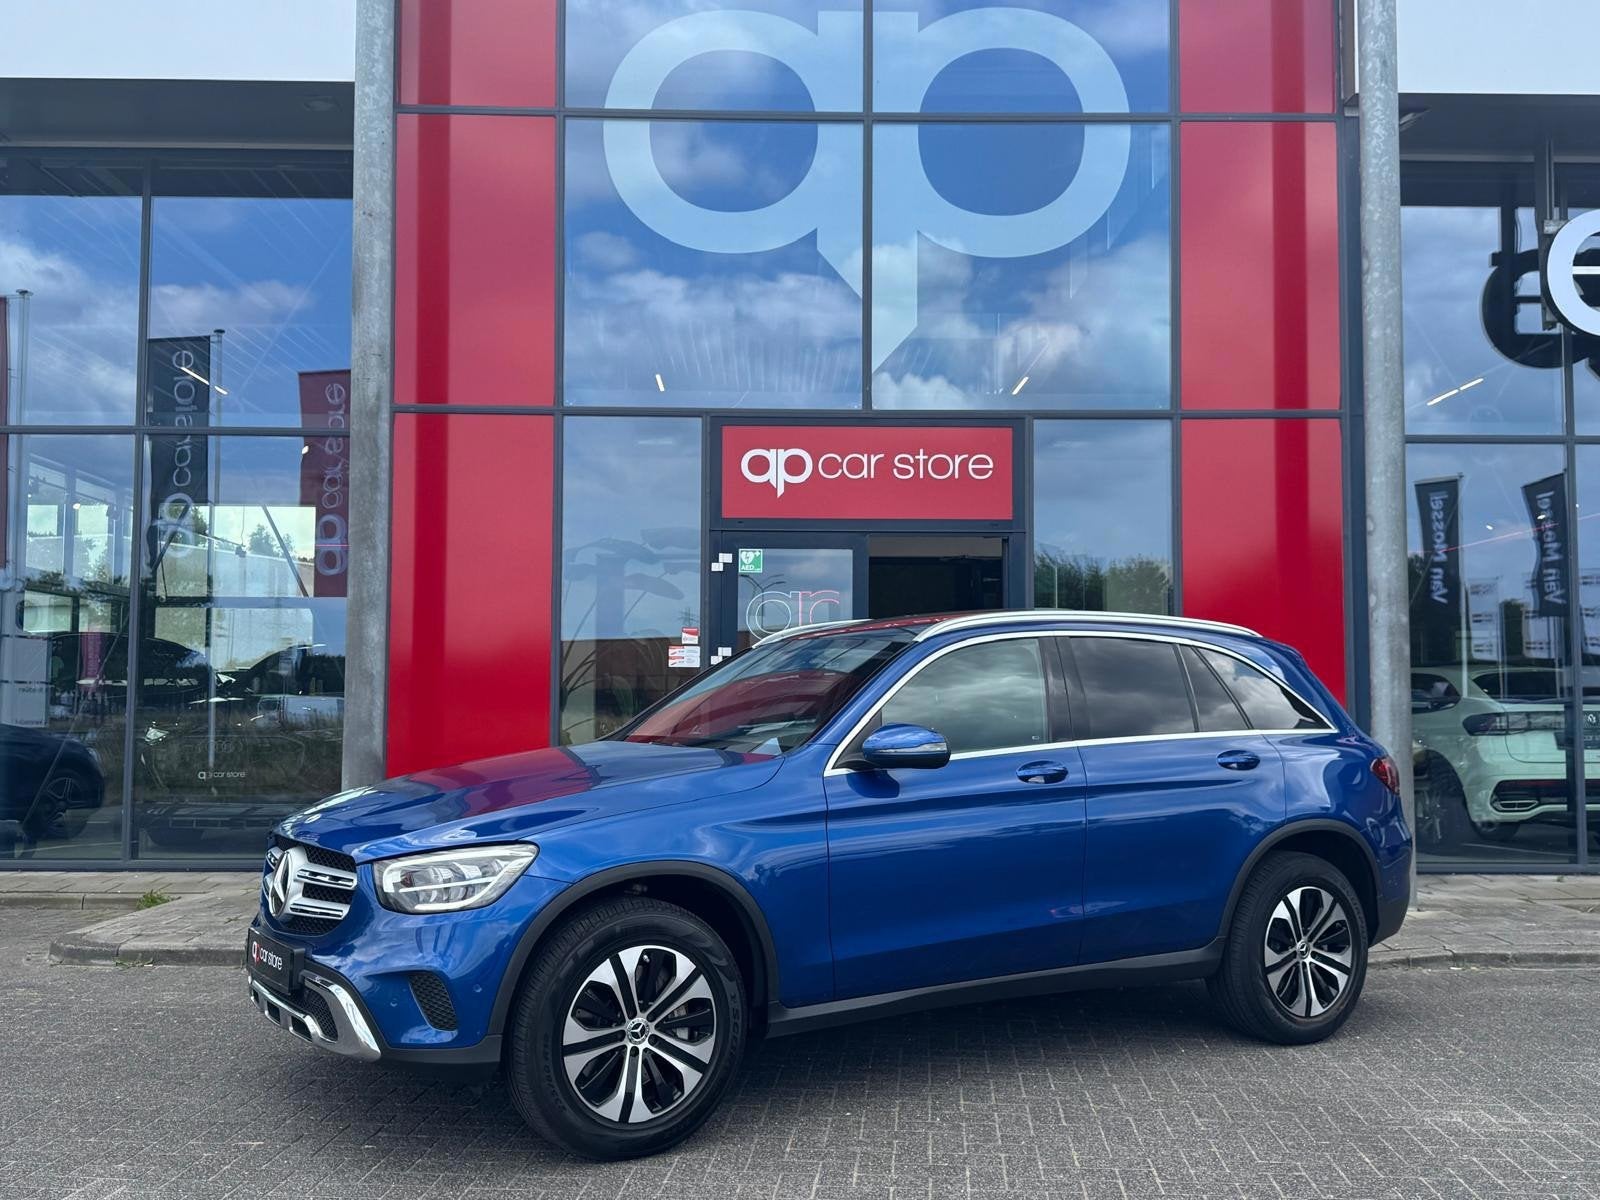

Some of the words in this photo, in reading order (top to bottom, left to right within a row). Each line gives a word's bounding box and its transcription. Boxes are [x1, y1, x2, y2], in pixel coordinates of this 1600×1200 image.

[818, 453, 885, 479] car
[892, 448, 994, 479] store
[260, 947, 268, 963] car
[268, 951, 283, 970] store
